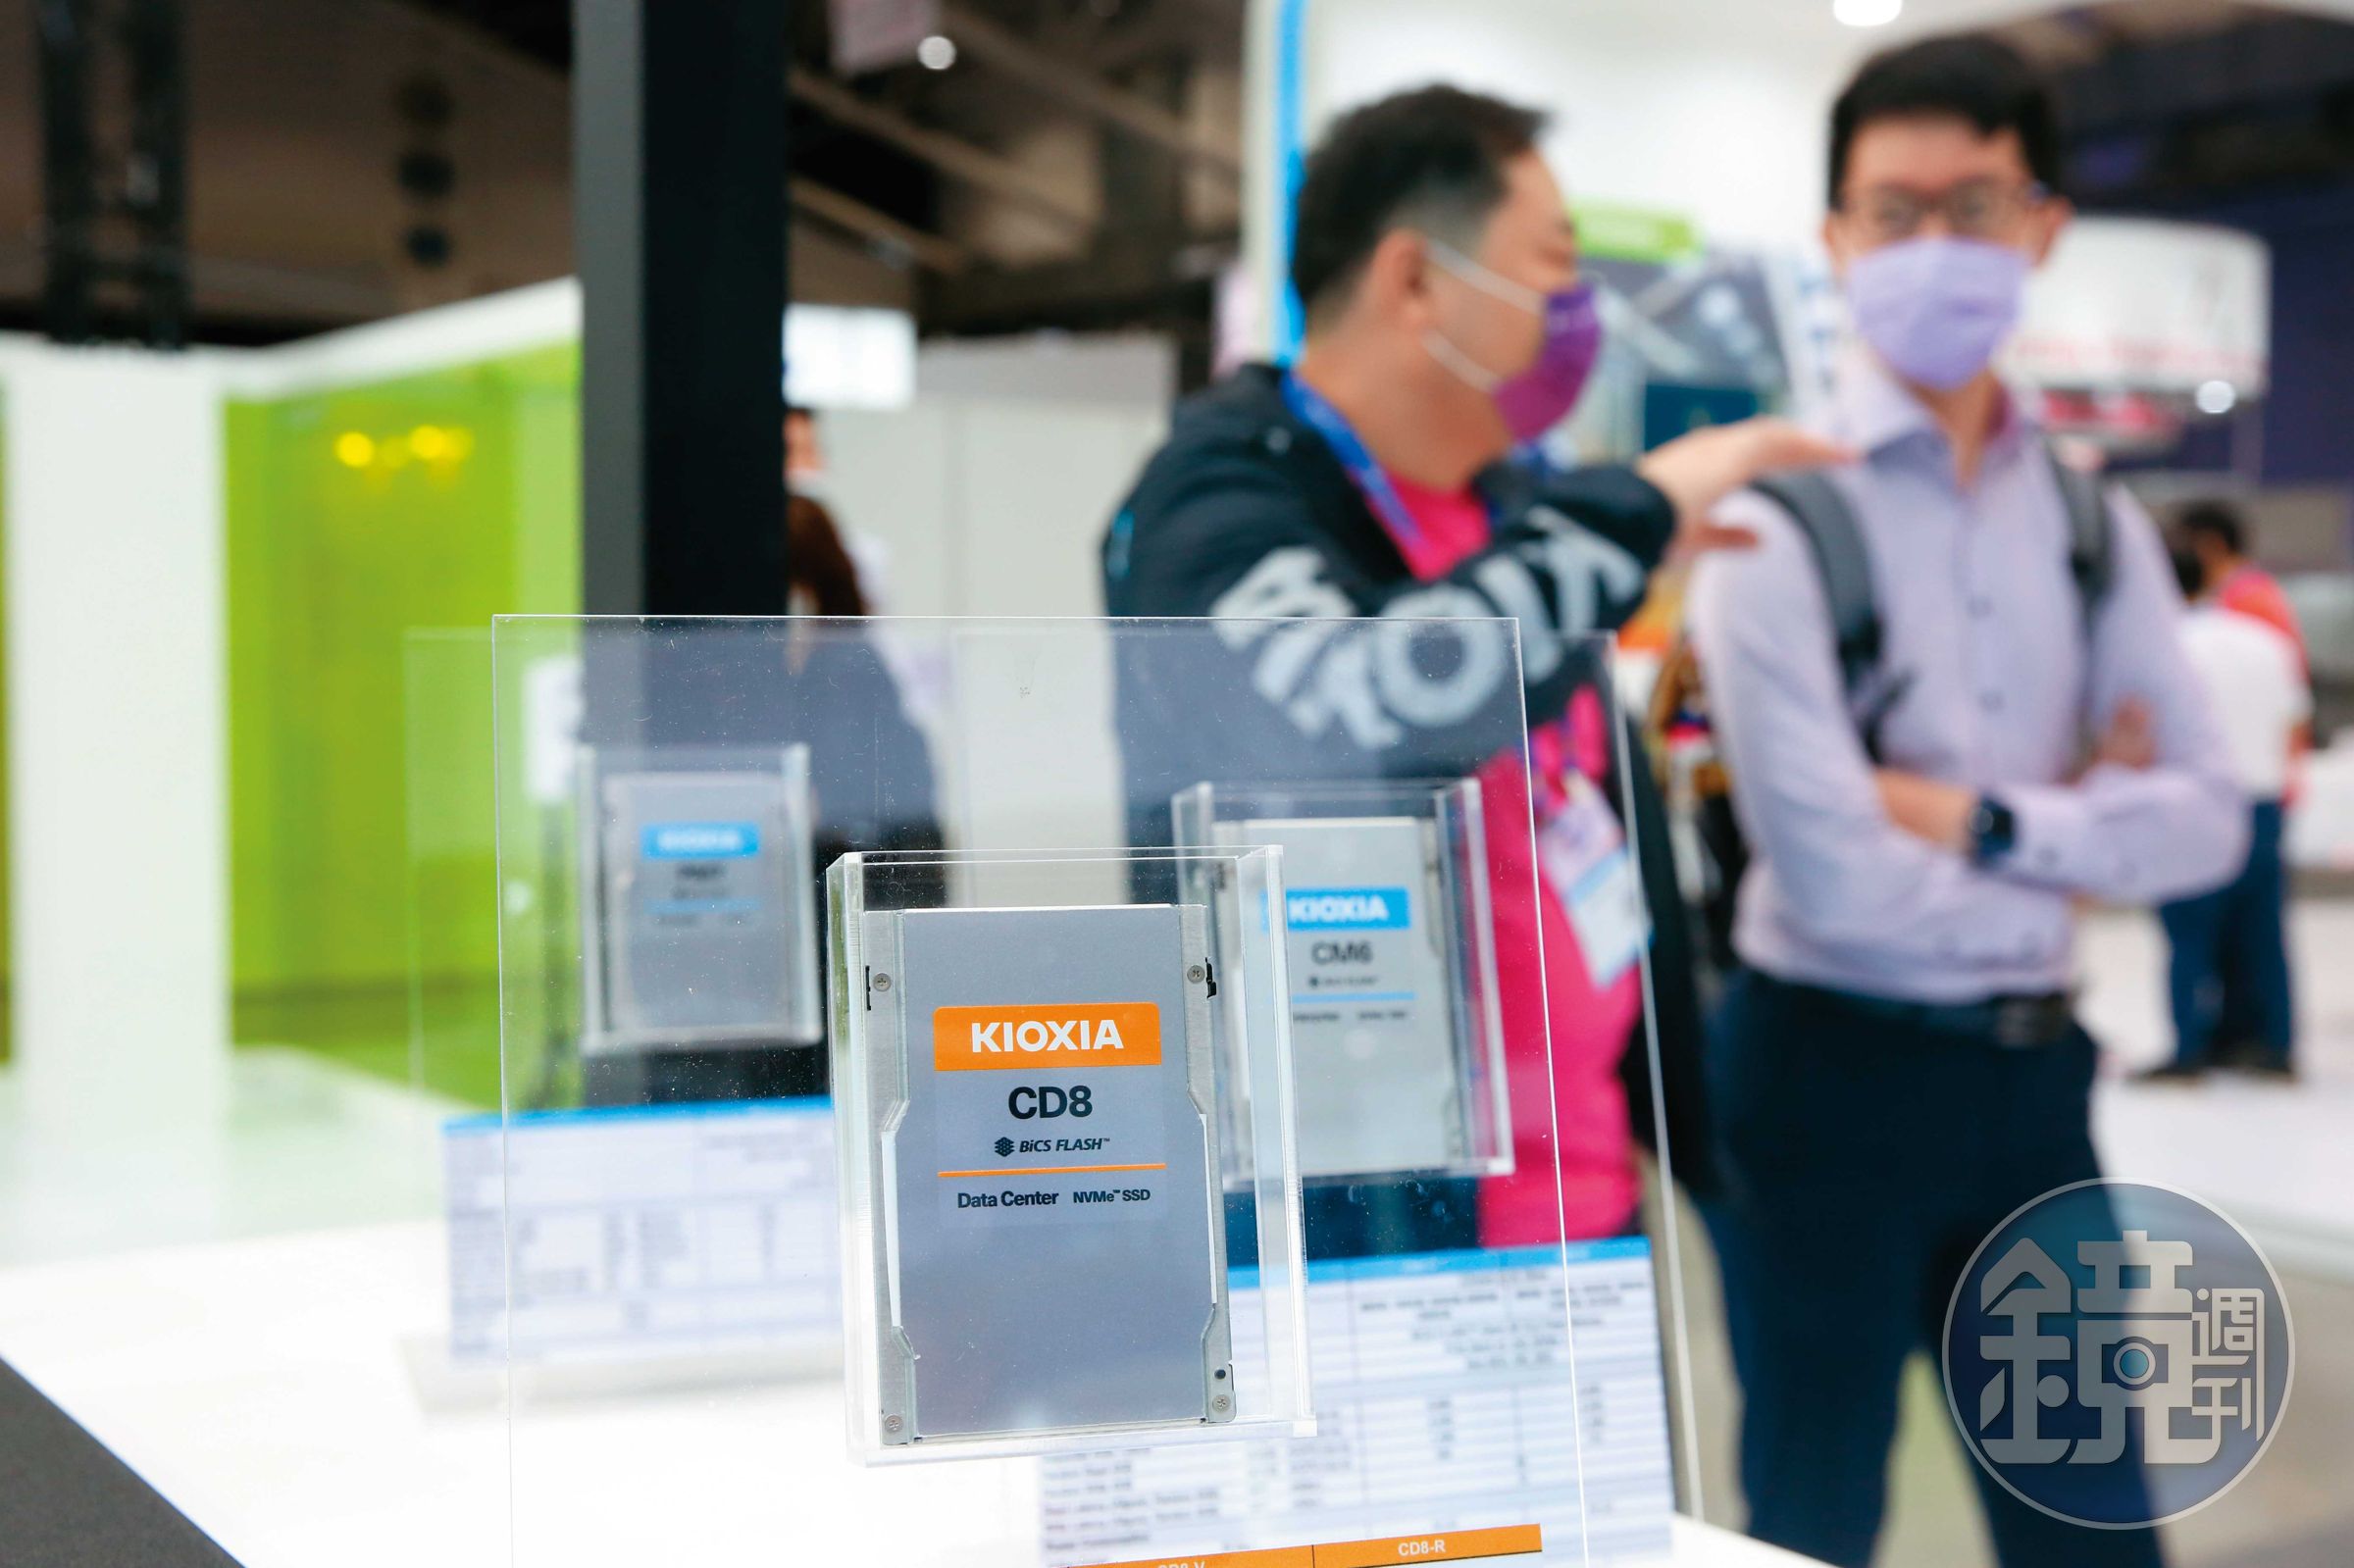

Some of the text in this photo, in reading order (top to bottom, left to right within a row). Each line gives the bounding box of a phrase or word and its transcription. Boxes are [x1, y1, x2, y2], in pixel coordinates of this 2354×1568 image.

[1287, 893, 1390, 924] KIOXIA
[1310, 940, 1373, 965] CM6
[971, 1019, 1124, 1053] KIOXIA
[1008, 1085, 1093, 1120] CD8
[1019, 1138, 1051, 1153] BiCS
[957, 1192, 998, 1209] Data
[1000, 1189, 1059, 1207] Center
[1122, 1189, 1151, 1202] SSD
[1398, 1539, 1447, 1557] CD8-R
